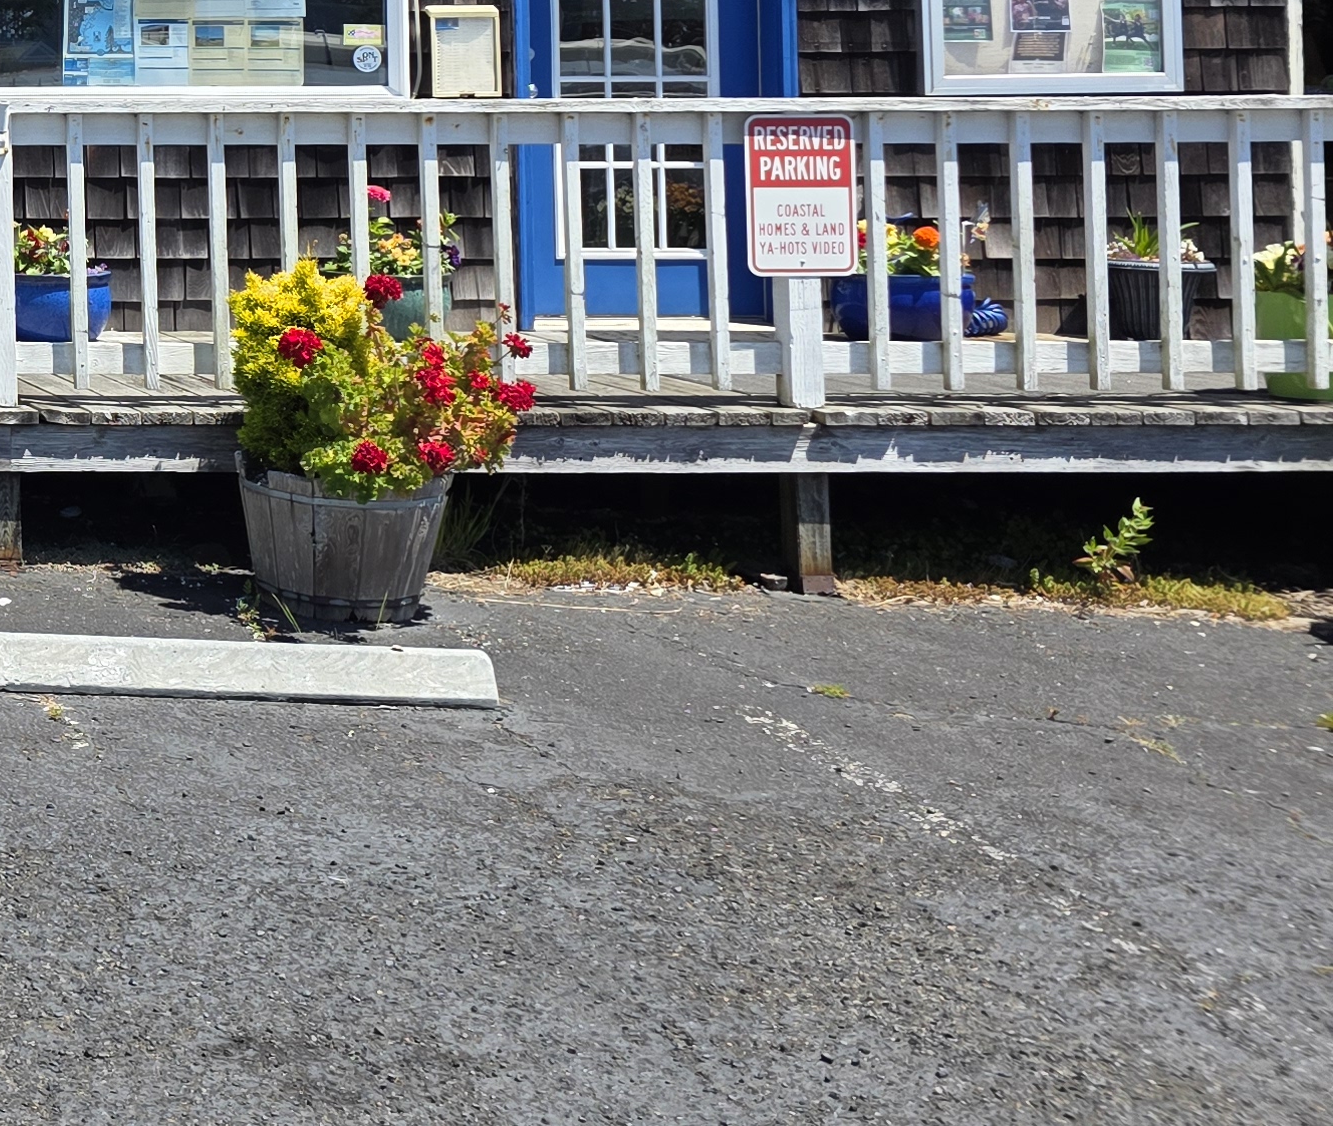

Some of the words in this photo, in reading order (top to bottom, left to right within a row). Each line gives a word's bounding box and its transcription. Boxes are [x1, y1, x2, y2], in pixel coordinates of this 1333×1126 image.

[753, 125, 845, 150] RESERVED
[759, 155, 840, 180] PARKING
[776, 203, 825, 217] COASTAL
[758, 222, 796, 236] HOMES
[800, 222, 809, 236] &
[815, 222, 844, 236] LAND
[759, 241, 807, 254] YA-HOTS
[811, 241, 844, 254] VIDEO
